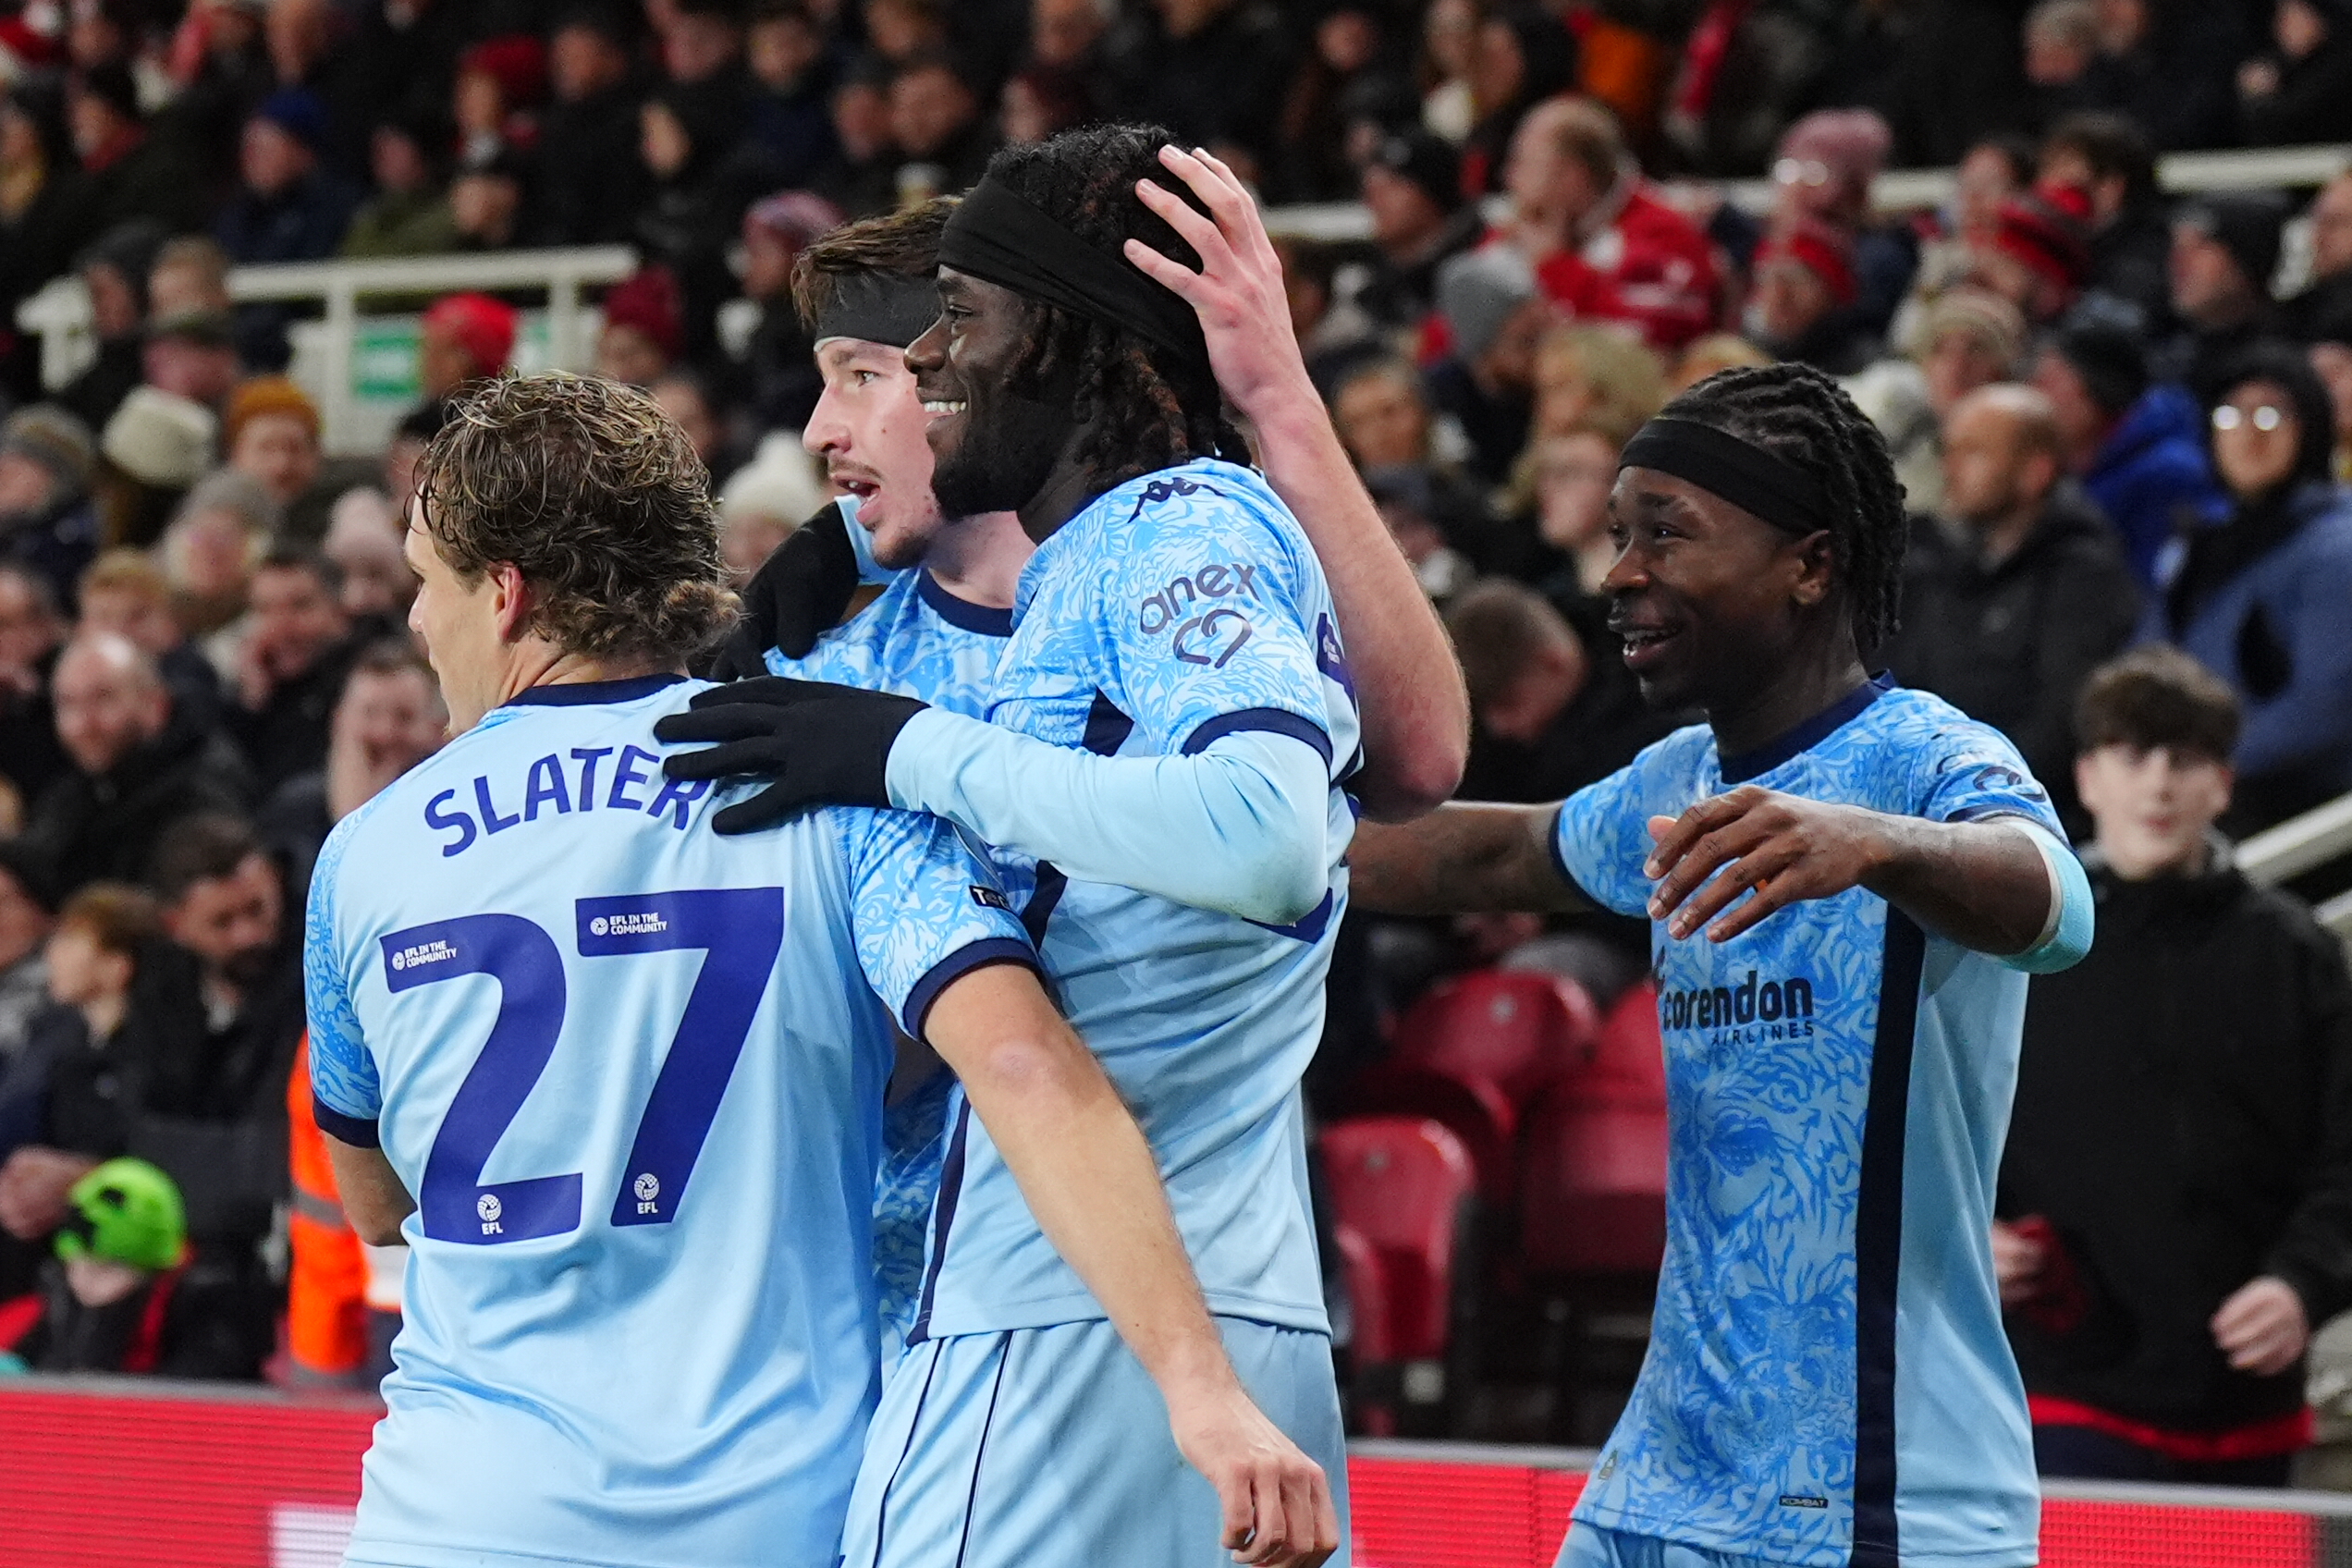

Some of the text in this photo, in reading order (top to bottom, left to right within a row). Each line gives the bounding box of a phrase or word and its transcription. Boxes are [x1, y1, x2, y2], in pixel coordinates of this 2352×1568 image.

[1140, 563, 1261, 635] anex
[424, 744, 714, 858] SLATER
[610, 912, 658, 925] EFL IN THE
[610, 921, 668, 936] COMMUNITY
[404, 939, 447, 959] EFL IN THE
[406, 947, 458, 969] COMMUNITY
[1712, 1020, 1815, 1047] AIRLINES
[380, 886, 784, 1245] 27
[637, 1201, 659, 1215] EFL
[481, 1221, 504, 1235] EFL
